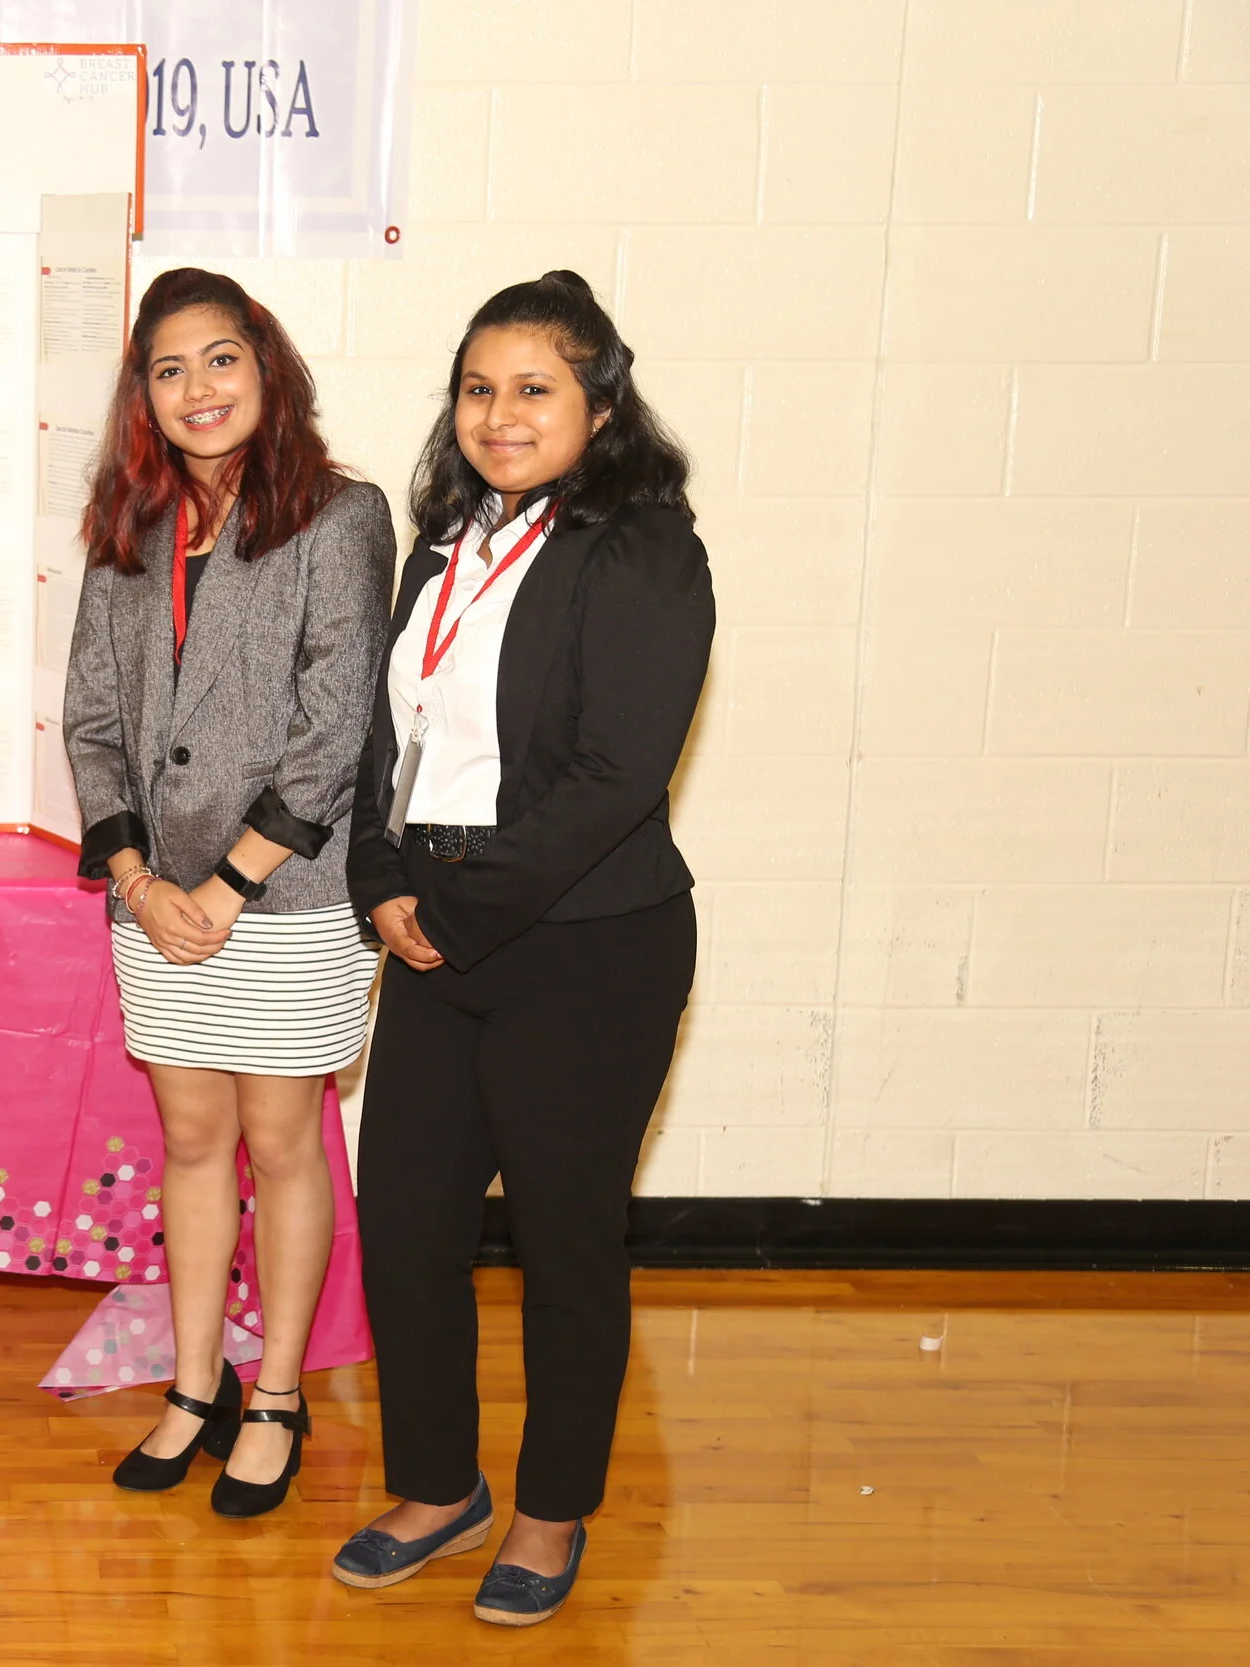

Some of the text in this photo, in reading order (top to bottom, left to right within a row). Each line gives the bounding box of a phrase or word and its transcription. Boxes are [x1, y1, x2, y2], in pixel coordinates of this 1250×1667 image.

[79, 58, 131, 69] BREAST
[79, 71, 135, 82] CANCER
[79, 84, 109, 94] HUB
[146, 58, 320, 150] 19, USA
